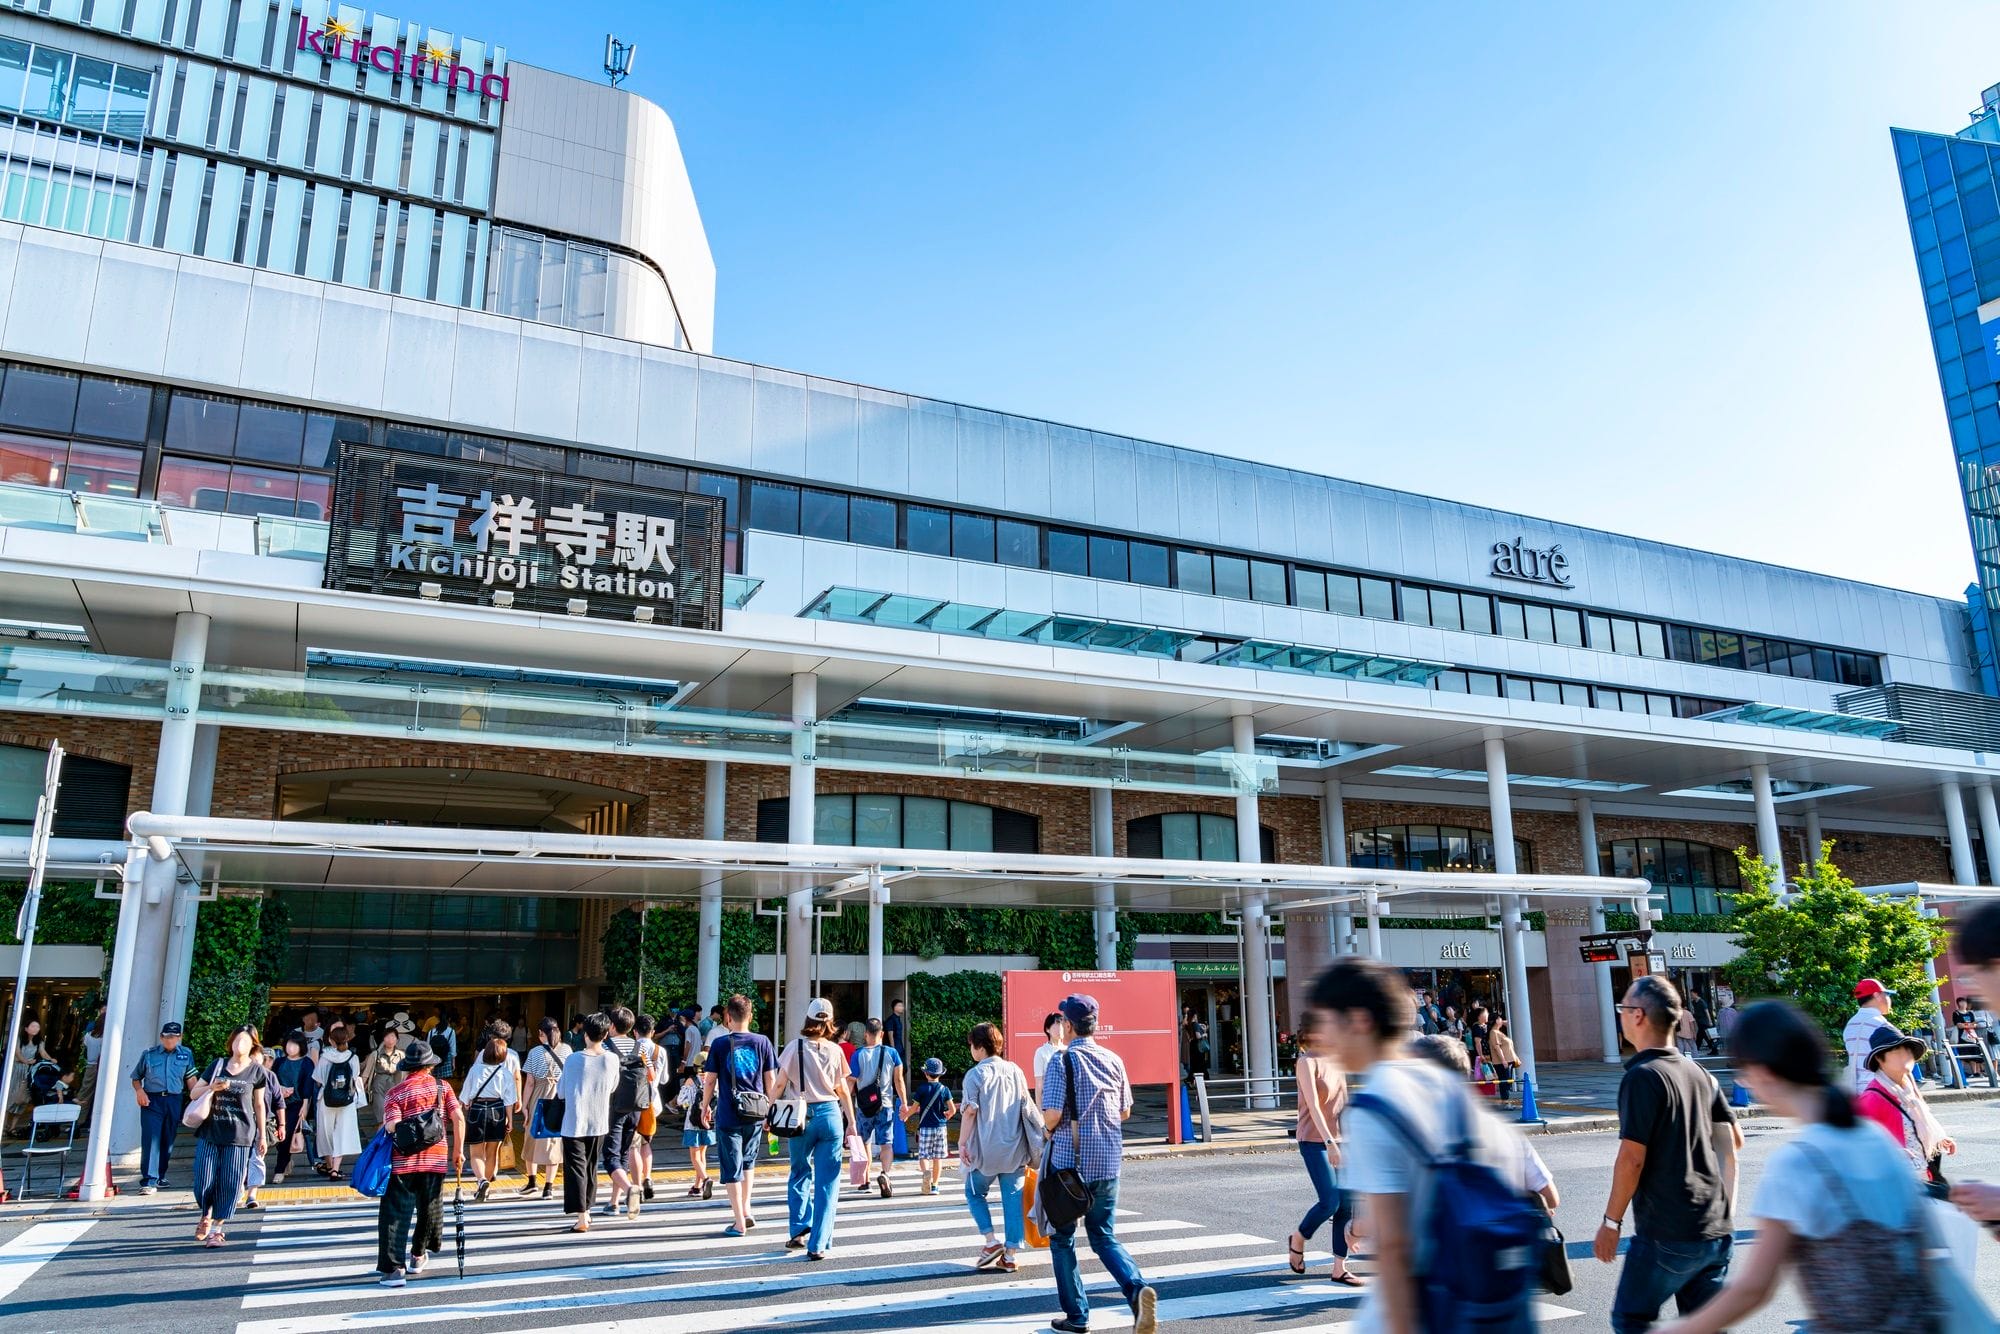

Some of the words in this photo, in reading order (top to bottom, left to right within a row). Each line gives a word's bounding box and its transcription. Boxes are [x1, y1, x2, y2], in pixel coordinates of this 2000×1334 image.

[297, 15, 510, 102] kirarina
[396, 482, 676, 576] 吉祥寺駅
[1494, 536, 1571, 584] atré
[560, 565, 674, 599] Station
[1441, 941, 1471, 959] atré
[1671, 943, 1696, 959] atré
